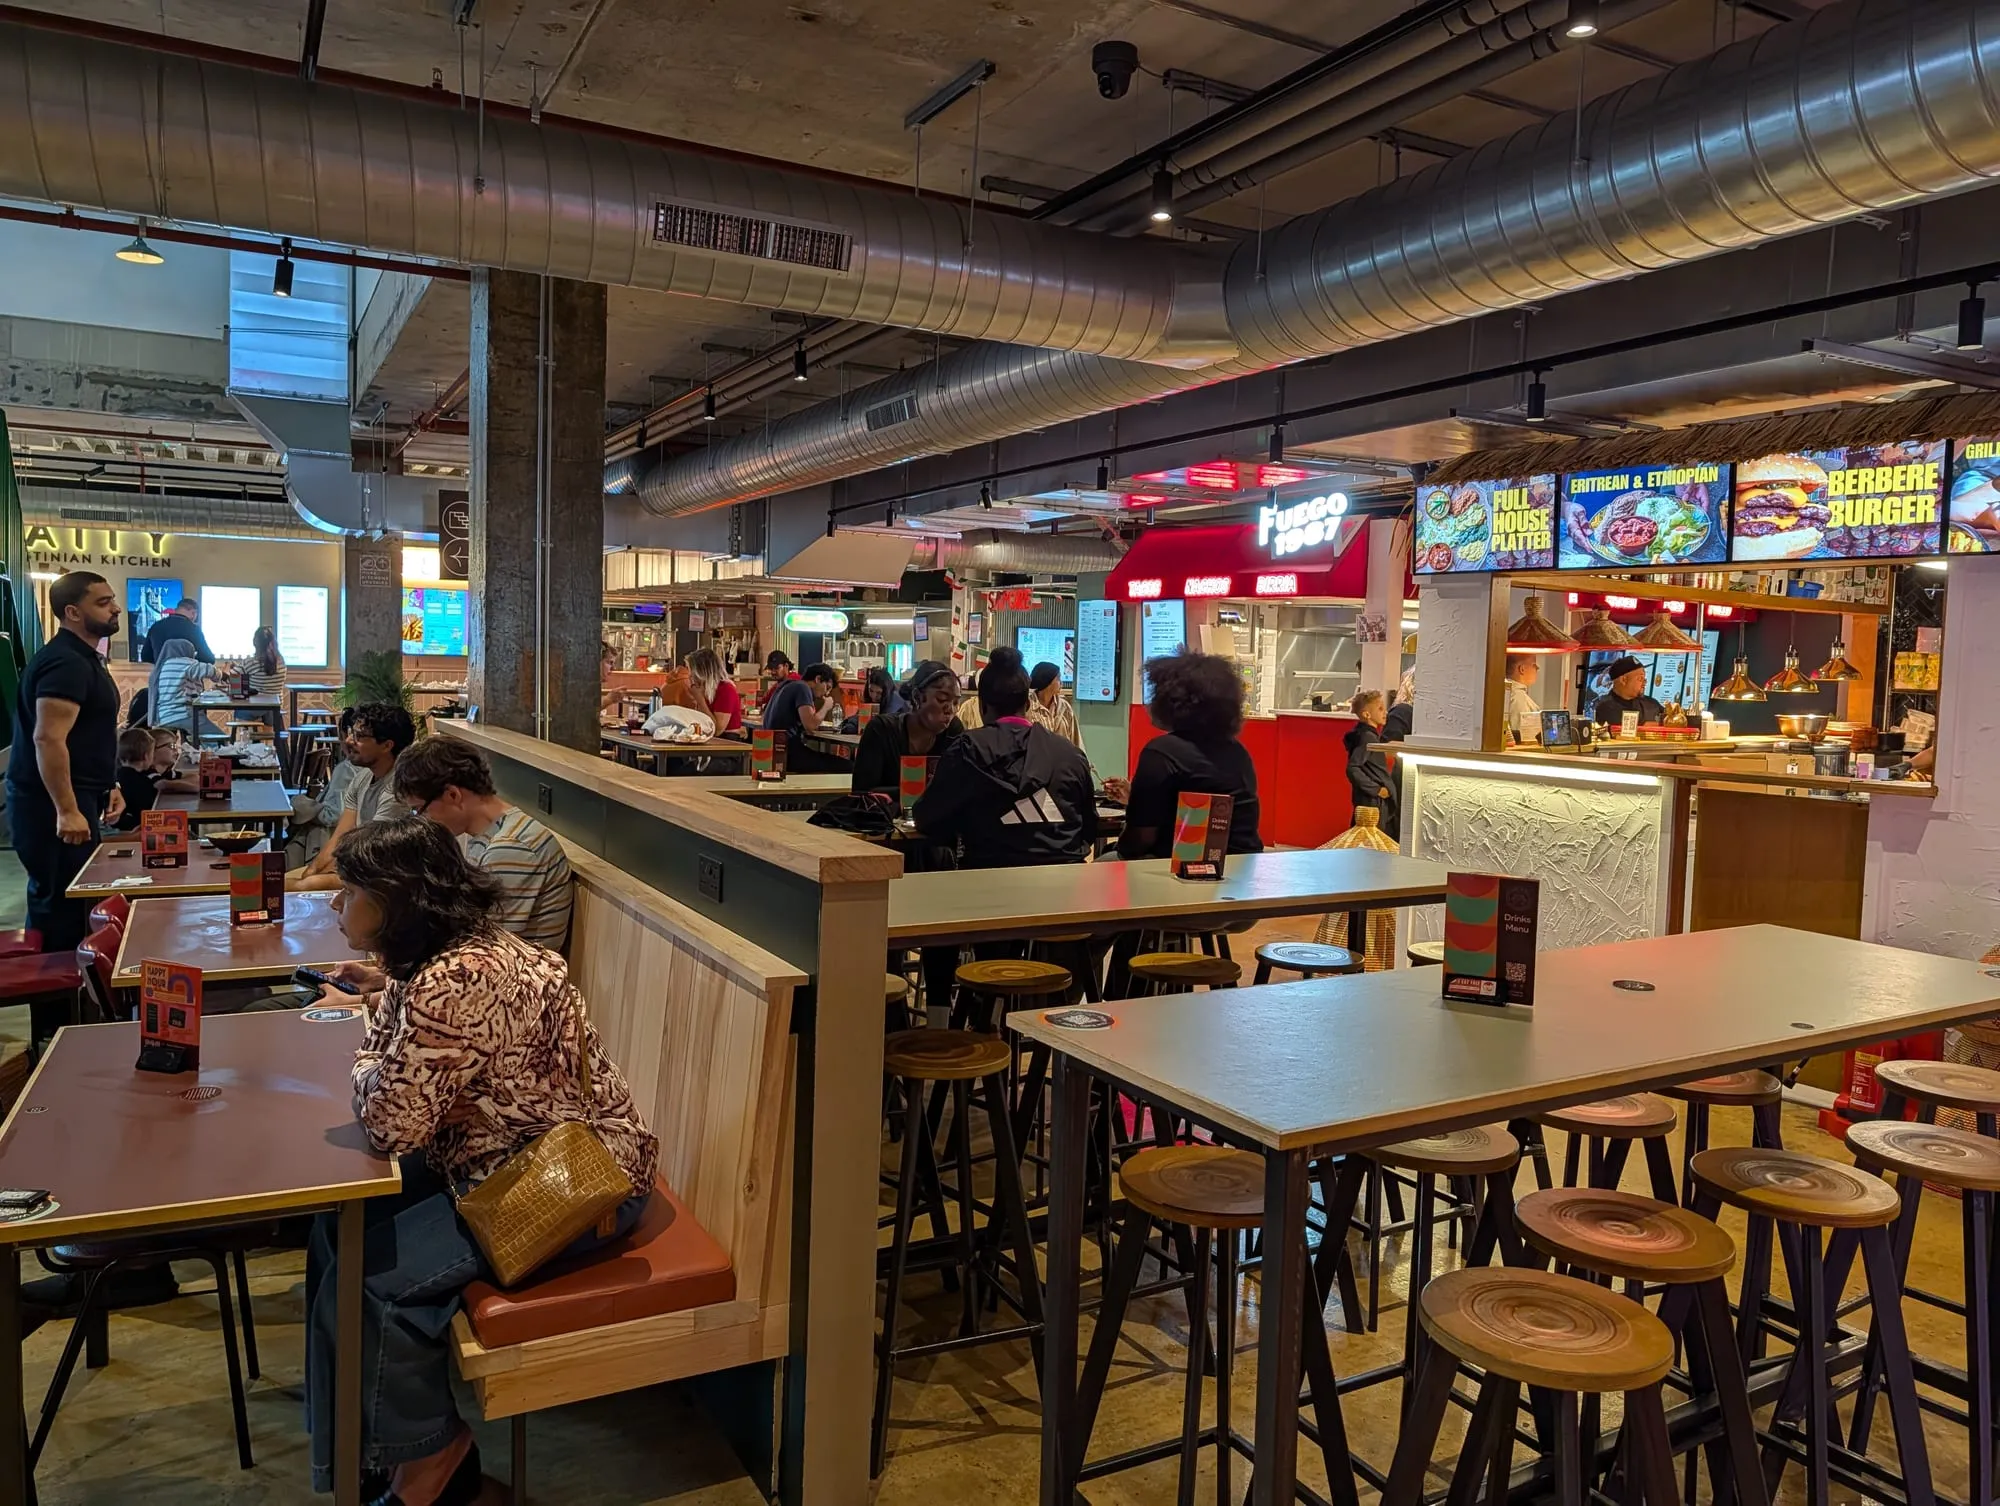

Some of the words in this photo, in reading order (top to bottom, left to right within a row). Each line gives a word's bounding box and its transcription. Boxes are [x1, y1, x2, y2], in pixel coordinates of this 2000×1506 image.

[1570, 475, 1629, 494] ERITREAN
[1633, 474, 1643, 488] &
[1647, 466, 1719, 488] ETHIOPIAN
[1828, 463, 1939, 496] BERBERE
[1493, 487, 1530, 511] FULL
[1259, 492, 1348, 546] FUEGO
[1493, 509, 1550, 533] HOUSE
[1827, 495, 1936, 527] BURGER
[1491, 531, 1551, 552] PLATTER
[101, 555, 171, 568] KITCHEN
[1185, 577, 1230, 595] NACHOS
[1256, 575, 1296, 593] BIRRIA
[1504, 913, 1531, 923] Drinks
[1505, 924, 1530, 934] Menu
[147, 967, 166, 977] HAPPY
